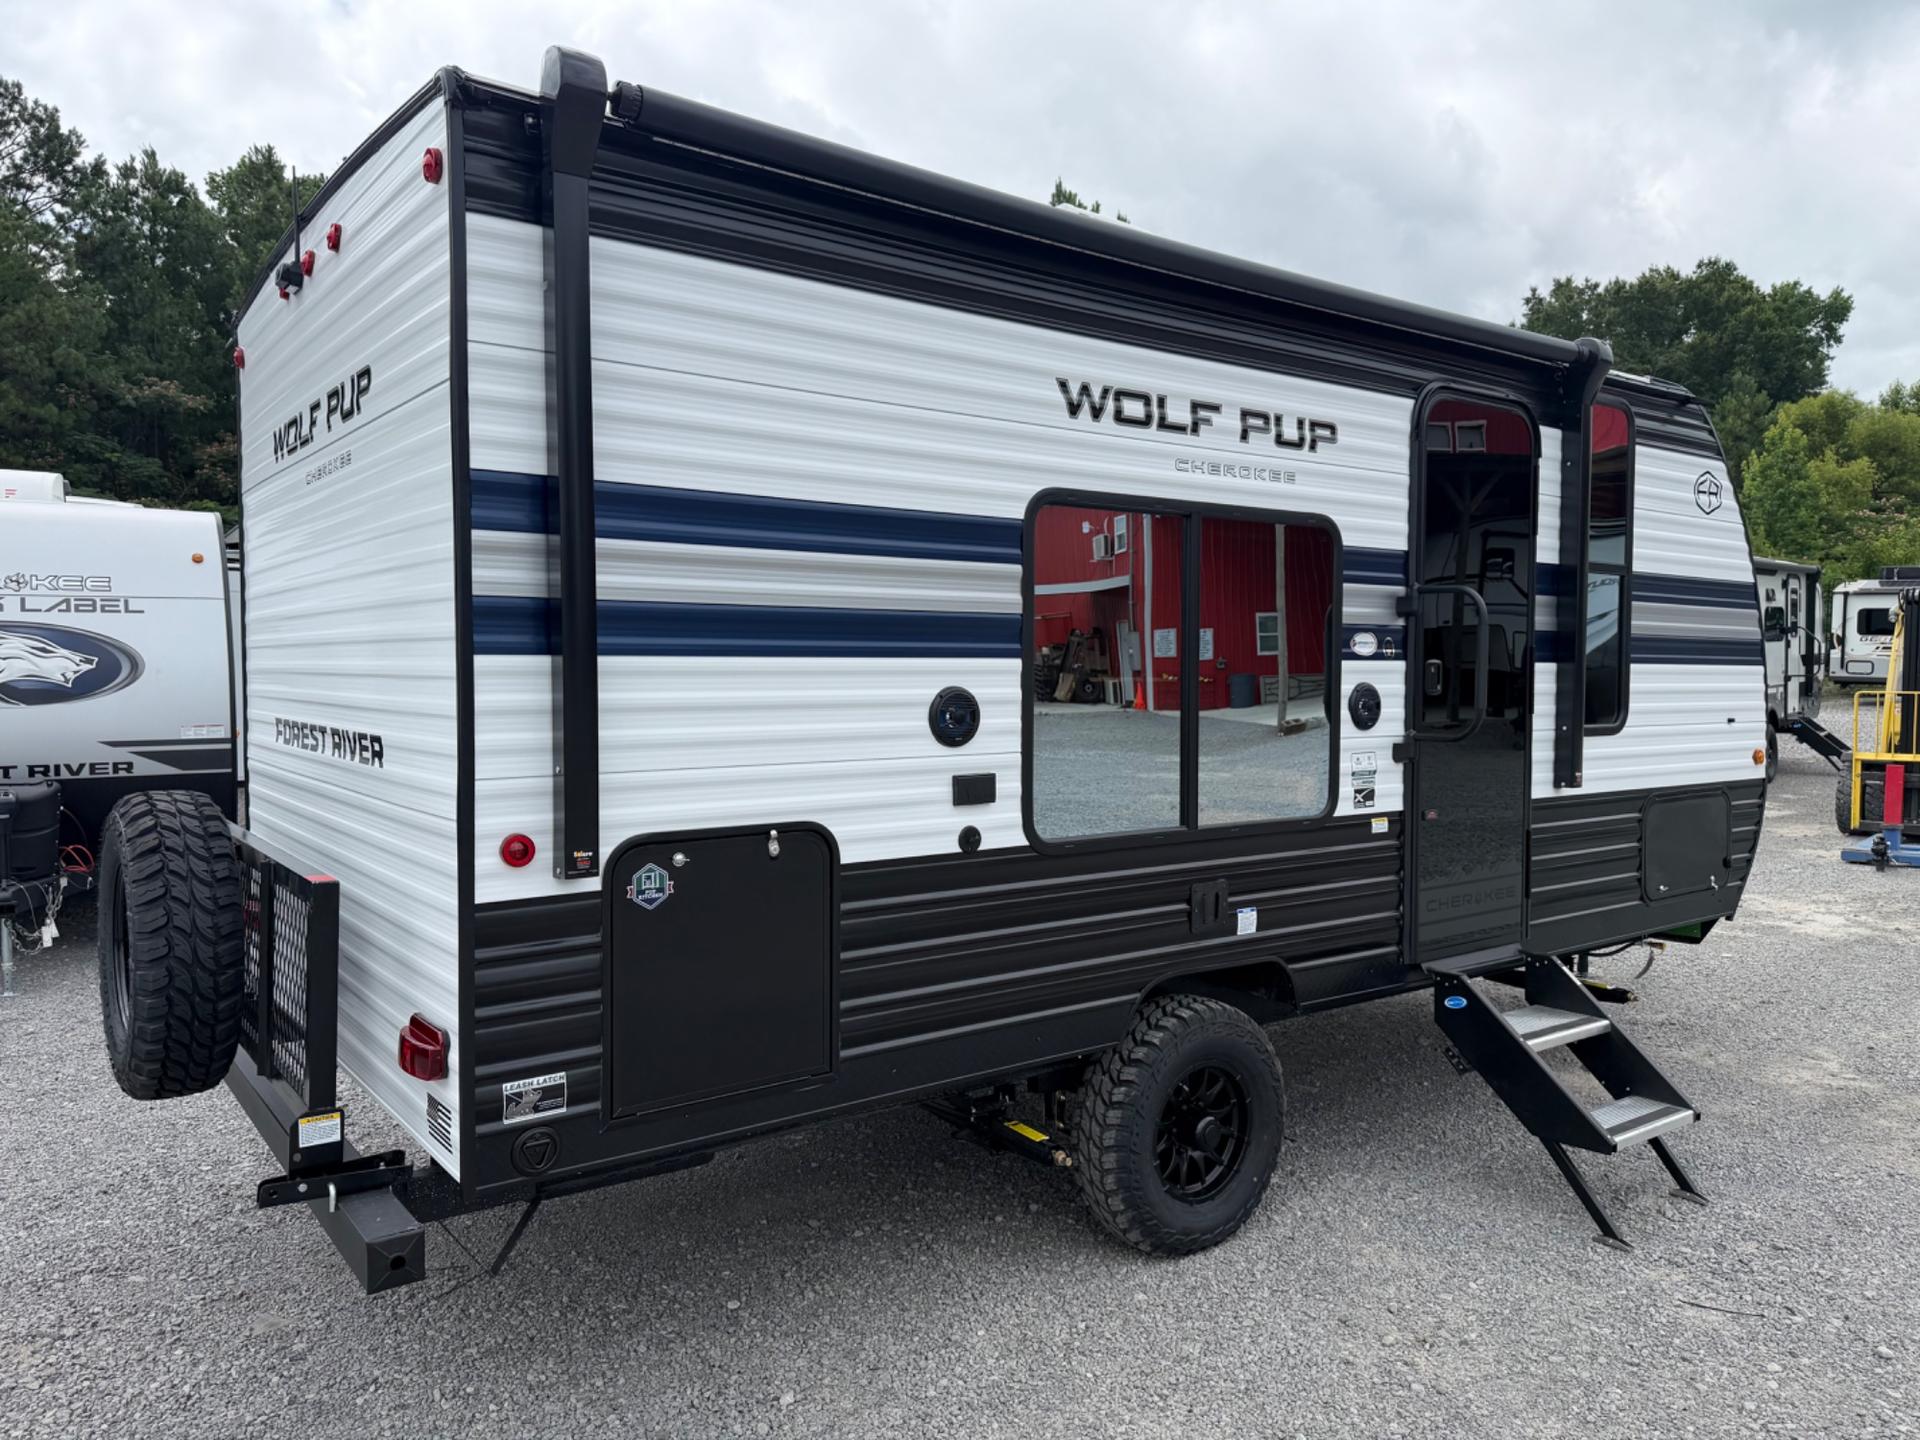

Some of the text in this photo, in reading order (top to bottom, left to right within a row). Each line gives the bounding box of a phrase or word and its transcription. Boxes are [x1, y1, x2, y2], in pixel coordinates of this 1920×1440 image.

[273, 364, 371, 463] WOLF PUP
[1056, 377, 1338, 453] WOLF PUP
[1175, 457, 1296, 484] CHEROKEE
[20, 597, 145, 613] LABEL
[275, 718, 384, 768] FOREST RIVER
[26, 761, 134, 778] RIVER
[1425, 885, 1516, 912] CHEROKEE
[504, 1075, 564, 1092] LEASH LATCH
